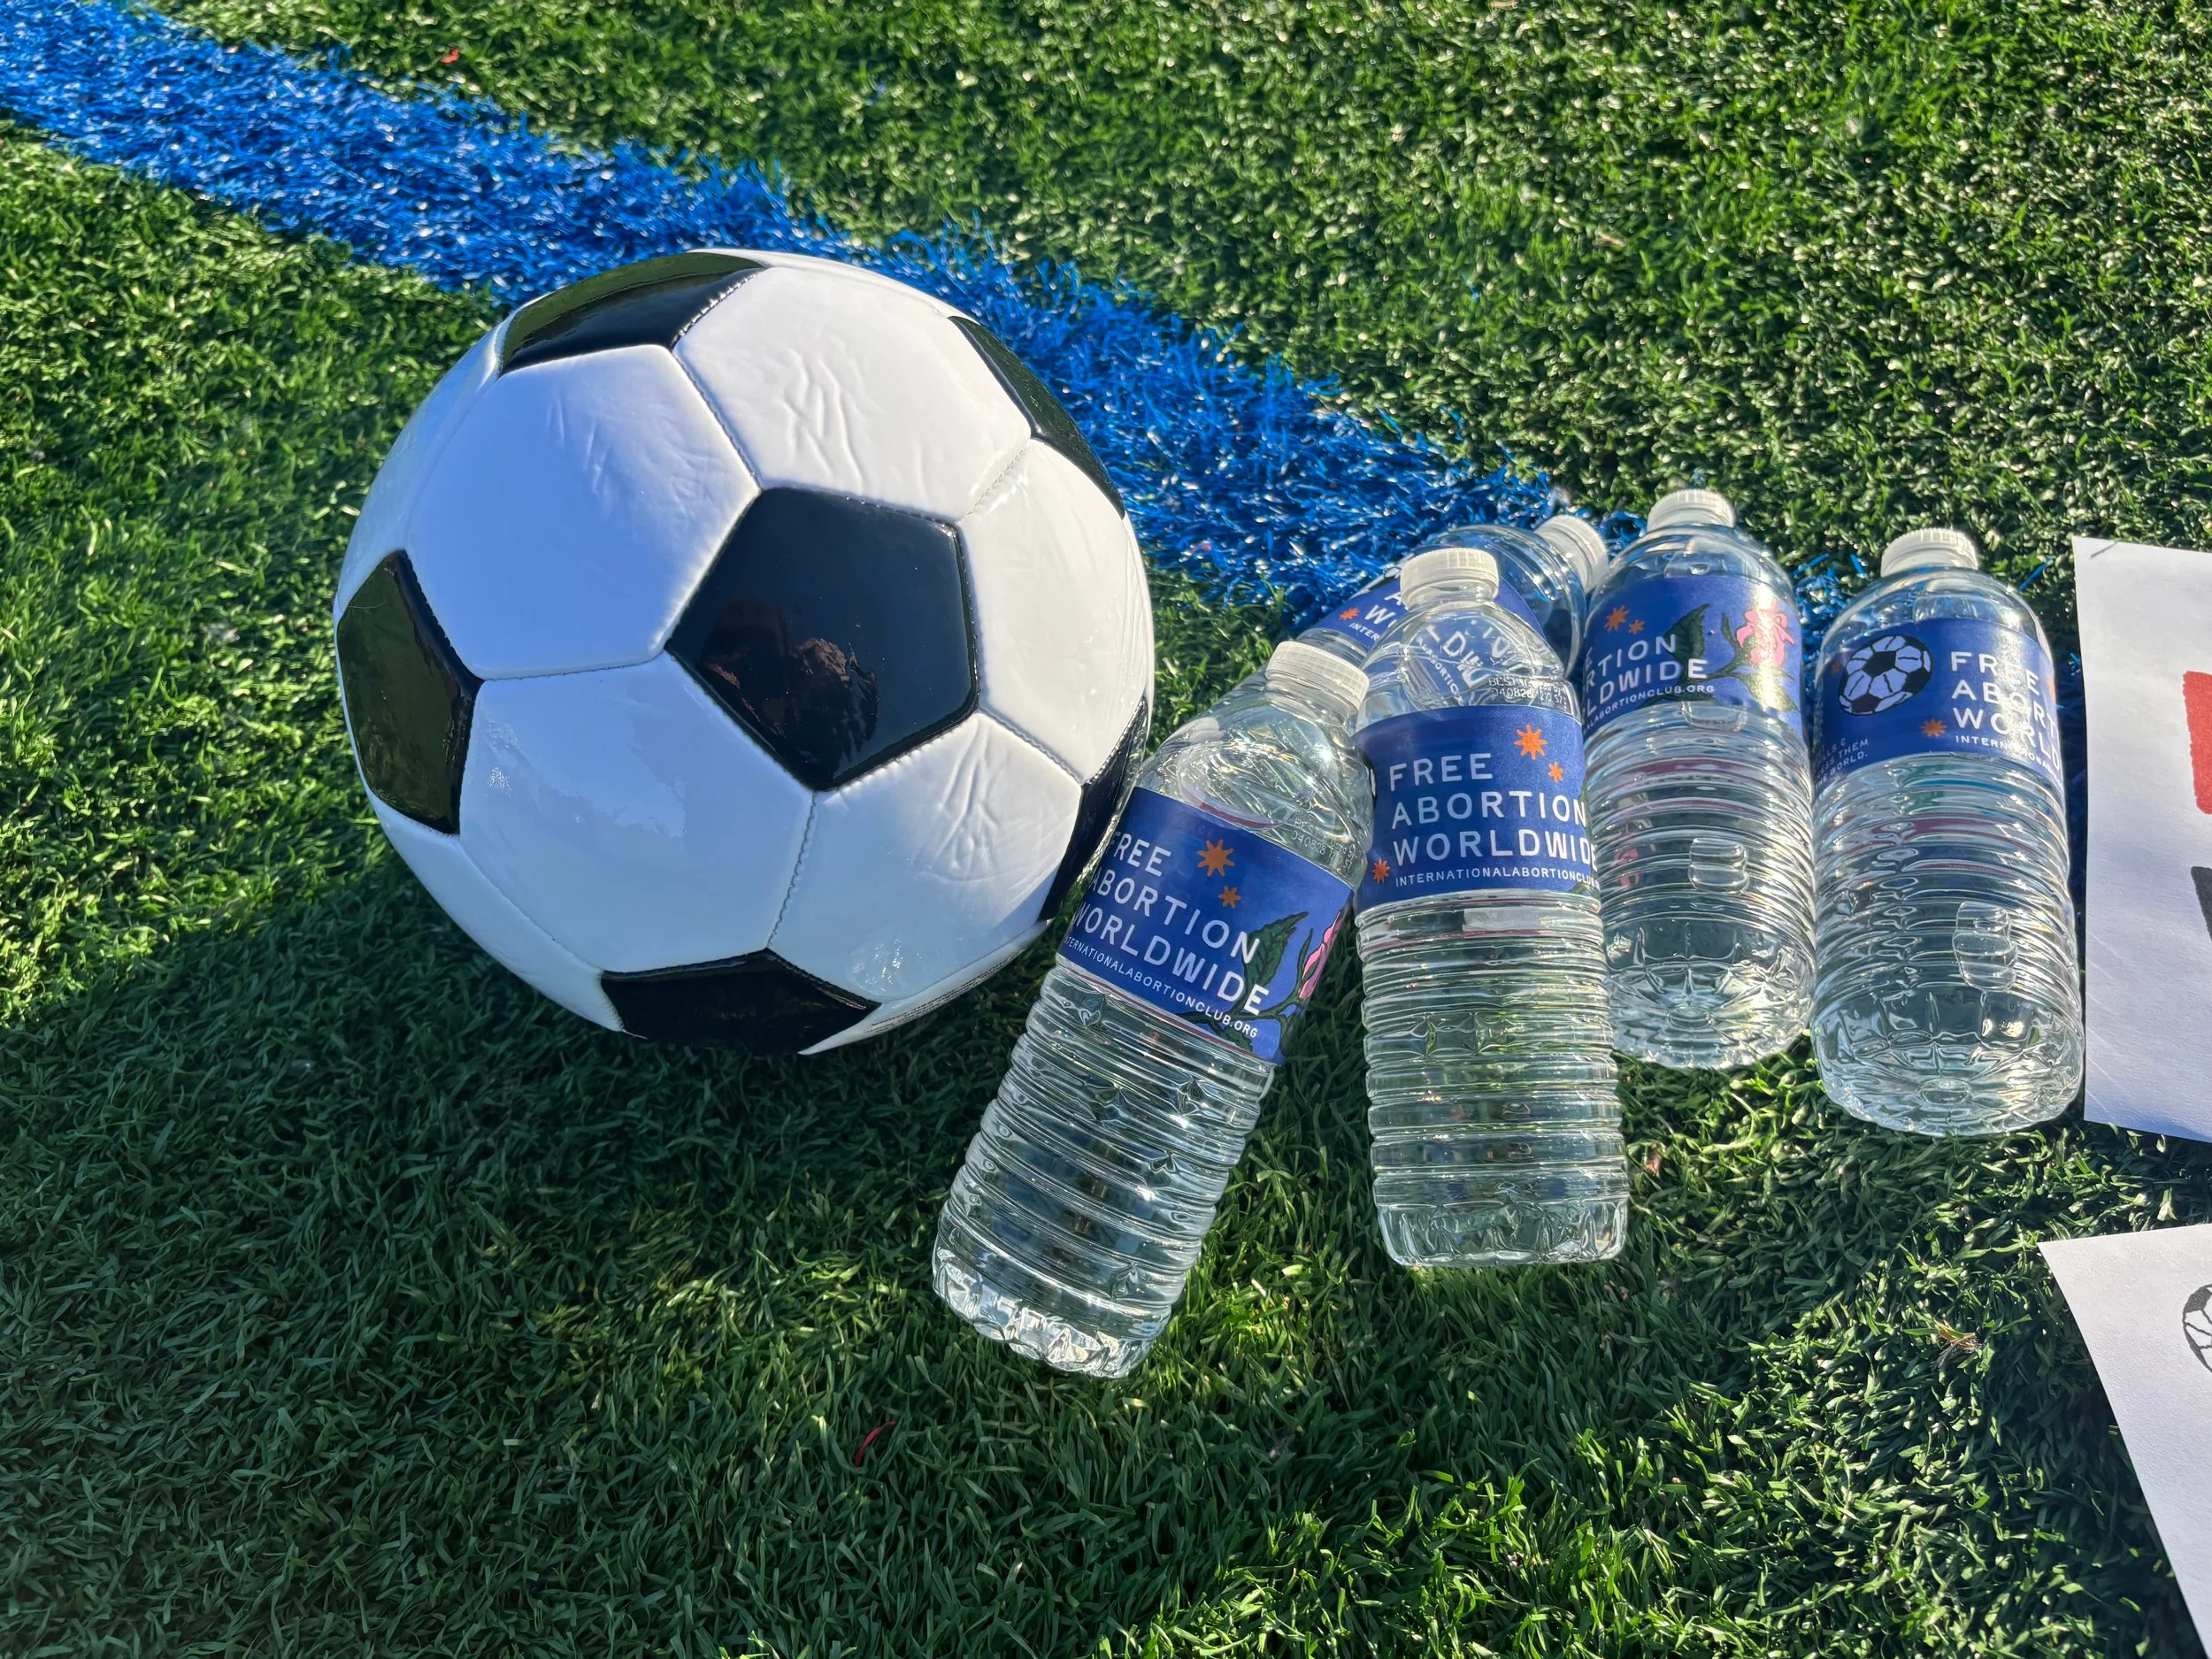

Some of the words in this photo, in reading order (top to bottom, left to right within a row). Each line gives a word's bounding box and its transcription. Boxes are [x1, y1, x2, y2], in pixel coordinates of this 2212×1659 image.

[1586, 634, 1677, 695] RTION
[1586, 658, 1709, 718] LDWIDE
[1951, 651, 2039, 696] FREE
[1389, 753, 1494, 792] FREE
[1392, 790, 1586, 830] ABORTION
[1394, 829, 1598, 872] WORLDWIDE
[1088, 866, 1260, 964] ABORTION
[1067, 902, 1270, 1016] WORLDWIDE
